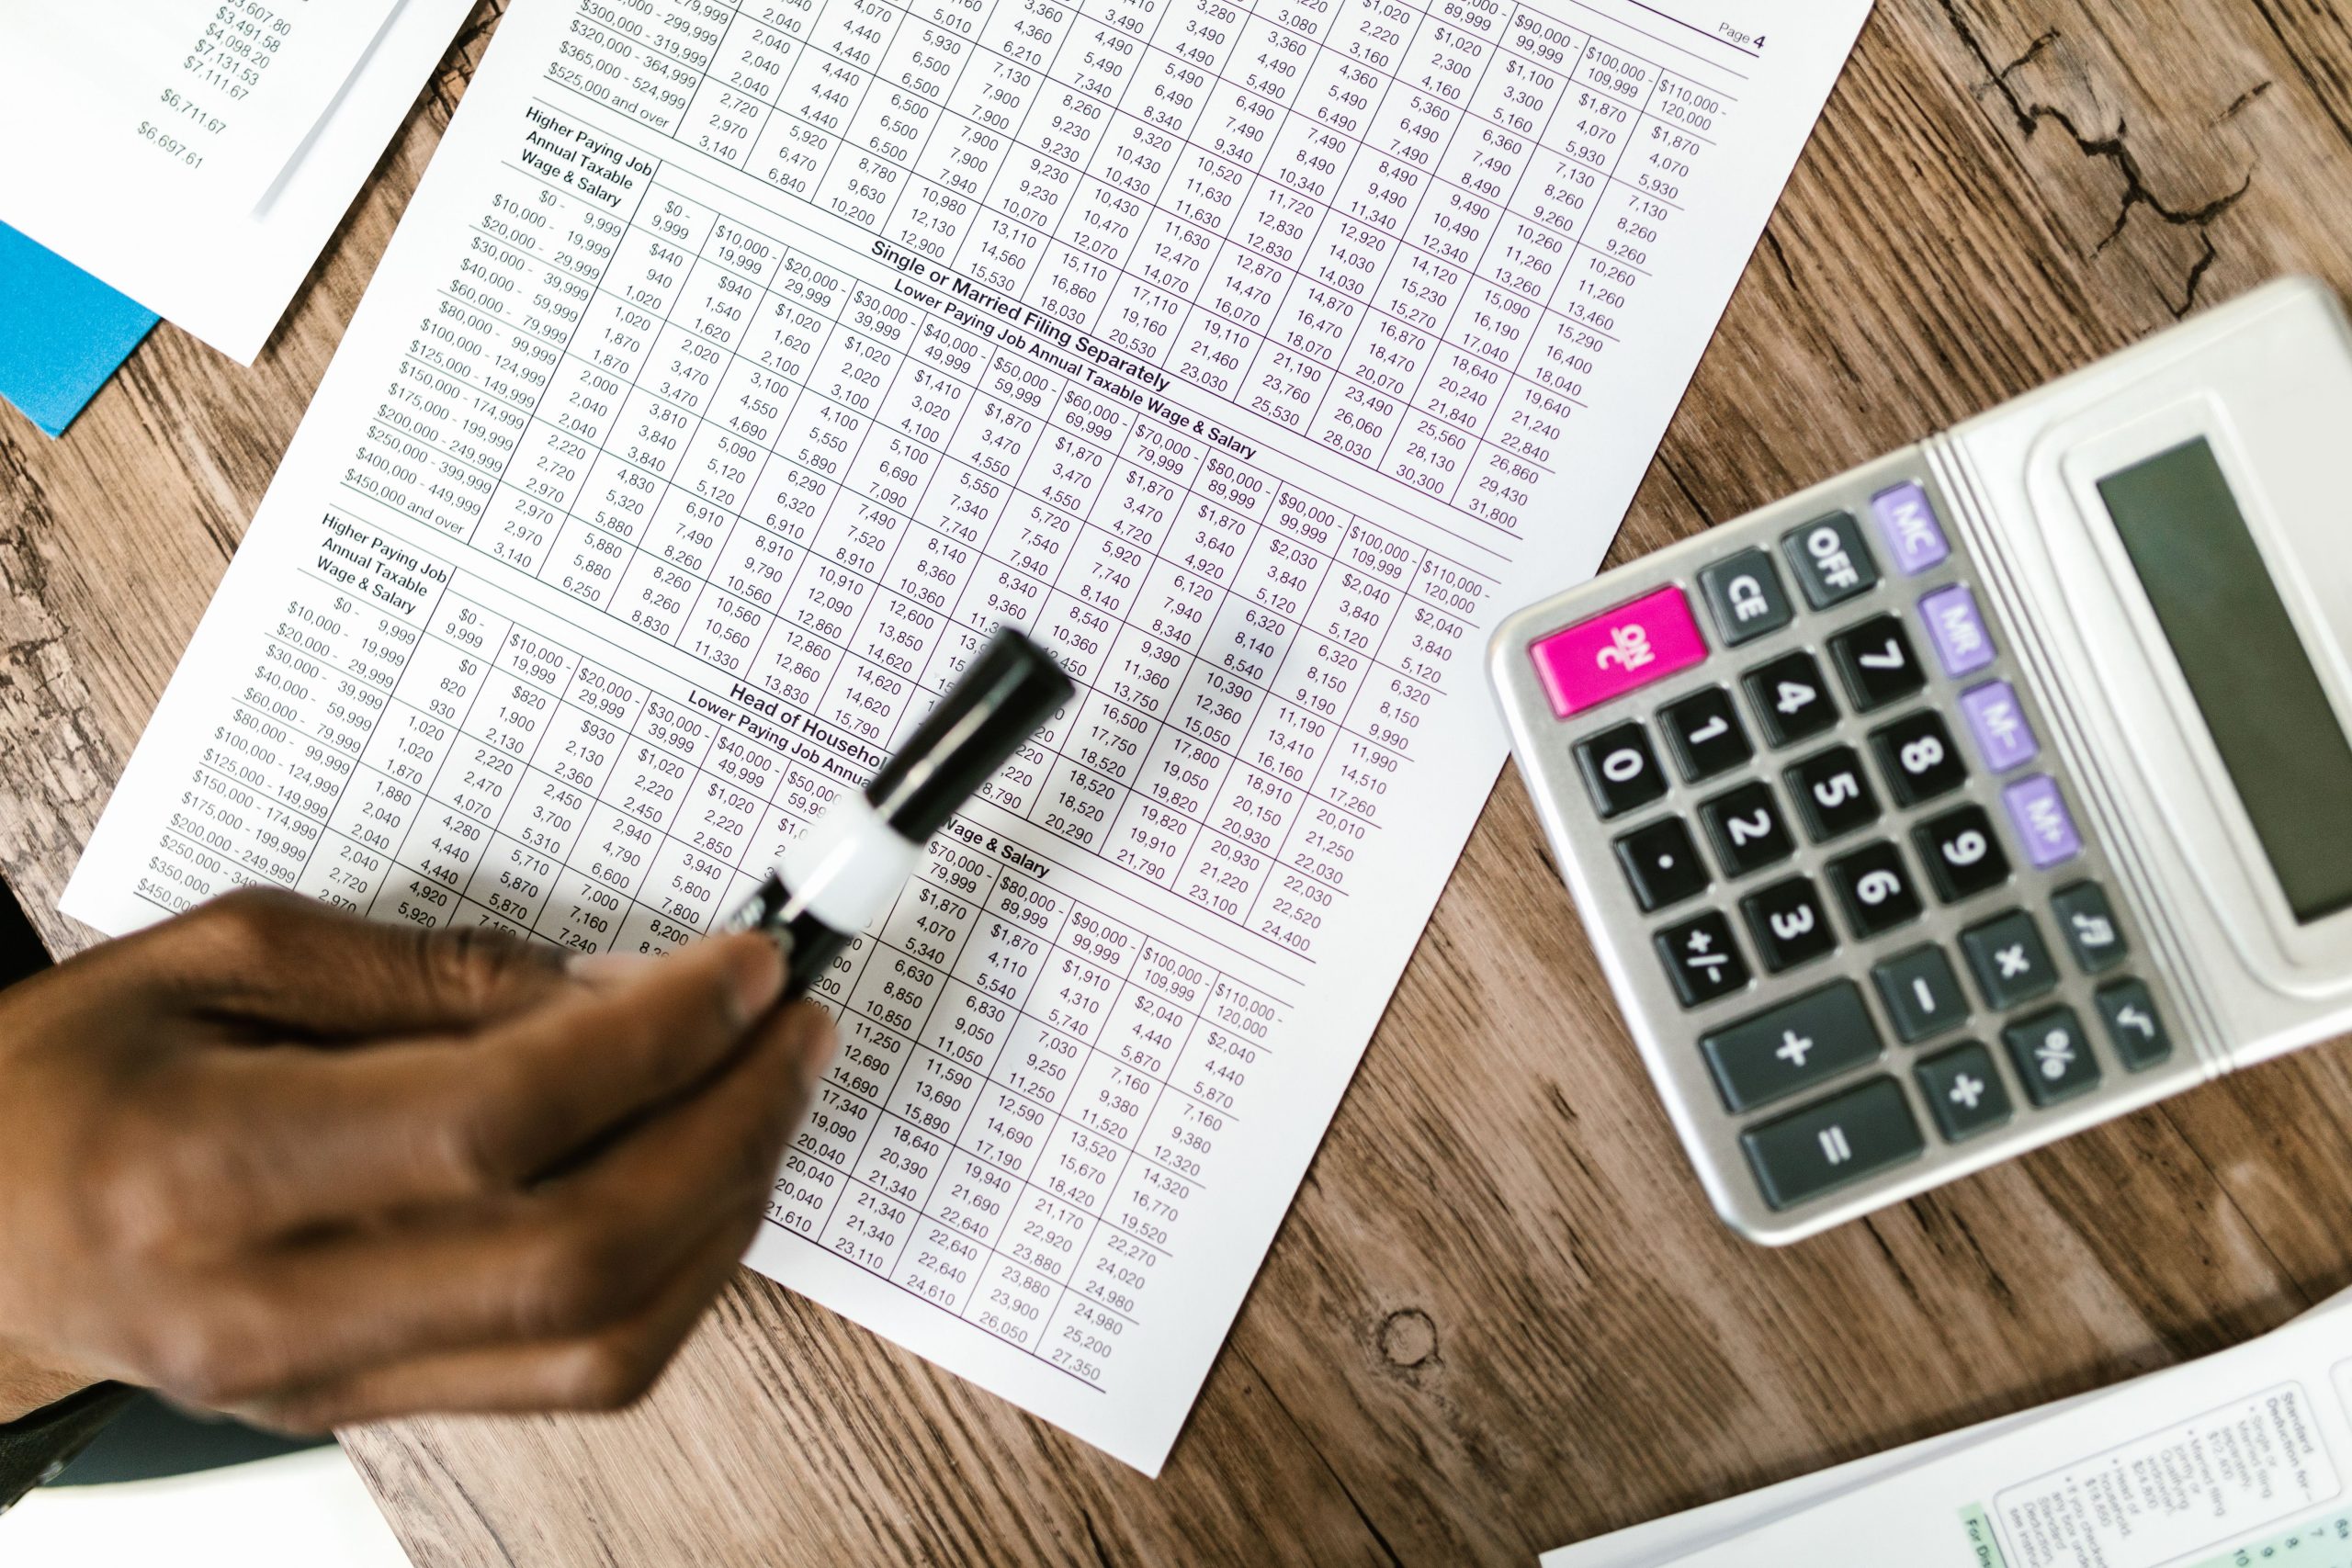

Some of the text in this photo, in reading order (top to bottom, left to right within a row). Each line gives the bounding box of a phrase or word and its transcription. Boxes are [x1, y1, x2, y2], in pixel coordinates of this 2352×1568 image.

[216, 6, 281, 53] $3,491.58
[1104, 8, 1145, 35] 3,490
[1514, 14, 1571, 48] $90,000
[1718, 21, 1767, 50] Page 4
[205, 22, 270, 69] $4,098.20
[1002, 40, 1042, 66] 6,210
[195, 39, 259, 85] $7,131.53
[821, 62, 860, 87] 4,440
[1430, 52, 1472, 79] 2,300
[184, 55, 249, 101] $7,111.67
[1589, 67, 1639, 98] 109,999
[548, 62, 670, 129] $525,000 and over
[1235, 95, 1275, 121] 6,490
[161, 88, 227, 135] $6,711.67
[137, 121, 203, 169] $6,697.61
[525, 106, 652, 176] Higher Paying Job
[1482, 129, 1522, 155] 6,360
[1650, 125, 1700, 156] $1,870
[525, 130, 633, 190] Annual Taxable
[521, 148, 622, 209] Wage & Salary
[767, 167, 806, 194] 6,840
[1187, 177, 1232, 208] 11,630
[1002, 197, 1047, 228] 10,070
[1544, 184, 1584, 210] 8,260
[583, 212, 622, 238] 9,999
[1340, 222, 1386, 252] 12,920
[715, 224, 770, 259] $10,000
[705, 296, 741, 321] 1,540
[1578, 279, 1625, 309] 11,260
[775, 302, 821, 333] $1,020
[870, 240, 1171, 393] Single or Married Filing Separately
[420, 318, 482, 356] $100,000
[893, 277, 1258, 461] Lower Paying Job Annual Taxable Wage & Salary
[1546, 344, 1593, 375] 16,400
[808, 426, 848, 453] 5,550
[1065, 412, 1113, 442] 69,999
[718, 436, 757, 463] 5,090
[970, 451, 1011, 477] 4,550
[616, 468, 655, 494] 4,830
[1489, 454, 1539, 485] 26,860
[345, 468, 465, 535] $450,000 and over
[503, 520, 543, 547] 2,970
[1894, 500, 1936, 554] MC
[321, 513, 447, 584] Higher Paying Job
[1807, 527, 1859, 588] OFF
[321, 536, 427, 597] Annual Taxable
[819, 565, 864, 595] 10,910
[317, 555, 417, 615] Wage & Salary
[728, 575, 773, 605] 10,560
[998, 571, 1037, 599] 8,340
[1728, 575, 1768, 622] CE
[1245, 609, 1285, 637] 6,320
[1940, 605, 1975, 659] MR
[1623, 624, 1655, 669] ON
[1860, 638, 1905, 669] 7
[512, 655, 556, 684] 19,999
[1124, 659, 1170, 690] 11,360
[1400, 656, 1442, 683] 5,120
[511, 685, 547, 711] $820
[1777, 681, 1816, 714] 4
[499, 706, 536, 732] 1,900
[729, 682, 888, 771] Head of Househol
[834, 709, 880, 739] 15,790
[1690, 716, 1728, 744] 1
[1351, 742, 1398, 773] 11,990
[1603, 749, 1644, 782] 0
[1900, 736, 1944, 773] 8
[288, 763, 340, 797] 124,999
[687, 689, 737, 722] Lower
[737, 714, 789, 751] Paying
[790, 742, 820, 764] Job
[985, 837, 999, 854] &
[1000, 844, 1051, 880] Salary
[1814, 773, 1860, 807] 5
[453, 794, 492, 820] 4,070
[543, 784, 582, 810] 2,450
[1141, 805, 1187, 836] 19,820
[1728, 809, 1771, 845] 2
[693, 831, 733, 859] 2,850
[1305, 830, 1354, 863] 21,250
[1943, 830, 1987, 865] 9
[409, 881, 447, 908] 4,920
[999, 875, 1056, 912] $80,000
[1857, 870, 1901, 905] 6
[488, 892, 528, 920] 5,870
[650, 919, 689, 946] 8,200
[1261, 919, 1311, 952] 24,400
[1770, 904, 1815, 941] 3
[989, 923, 1039, 956] $1,870
[1059, 987, 1100, 1014] 4,310
[854, 1021, 901, 1054] 11,250
[954, 1017, 995, 1045] 9,050
[1193, 1080, 1234, 1109] 5,870
[786, 1156, 834, 1188] 20,040
[878, 1147, 928, 1180] 20,390
[965, 1162, 1012, 1194] 19,940
[1060, 1154, 1106, 1185] 15,670
[834, 1236, 884, 1269] 23,110
[2267, 1397, 2300, 1468] Deduction
[2281, 1392, 2314, 1454] Standard
